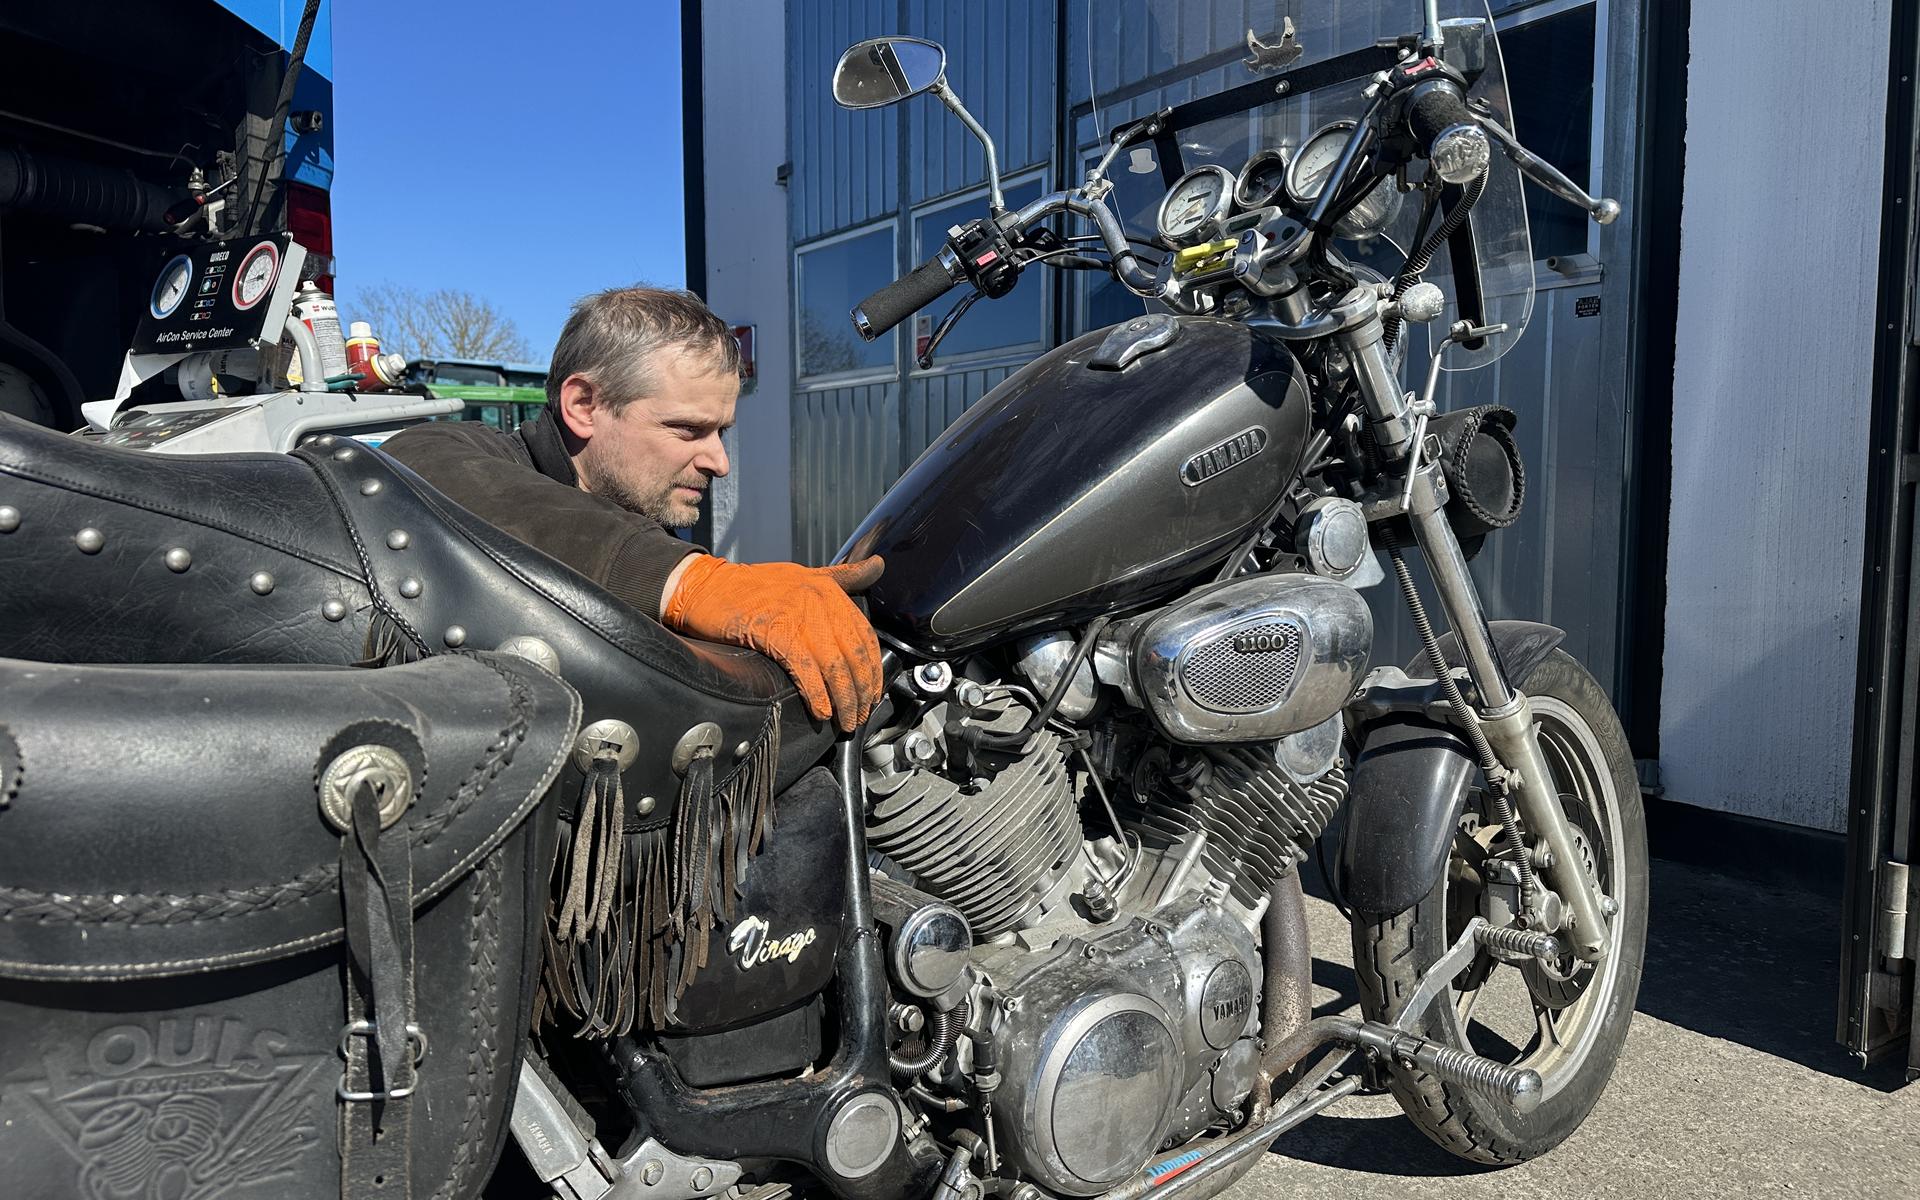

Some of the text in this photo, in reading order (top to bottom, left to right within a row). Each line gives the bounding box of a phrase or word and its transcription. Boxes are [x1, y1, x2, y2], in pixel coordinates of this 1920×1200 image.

[210, 251, 230, 262] WAECO
[156, 326, 234, 343] AirCon Service Center
[1191, 430, 1262, 480] YAMAHA
[1240, 634, 1285, 651] 1100
[730, 915, 817, 969] Virago
[111, 1073, 227, 1097] LEATHER
[528, 1120, 553, 1155] YAMAHA
